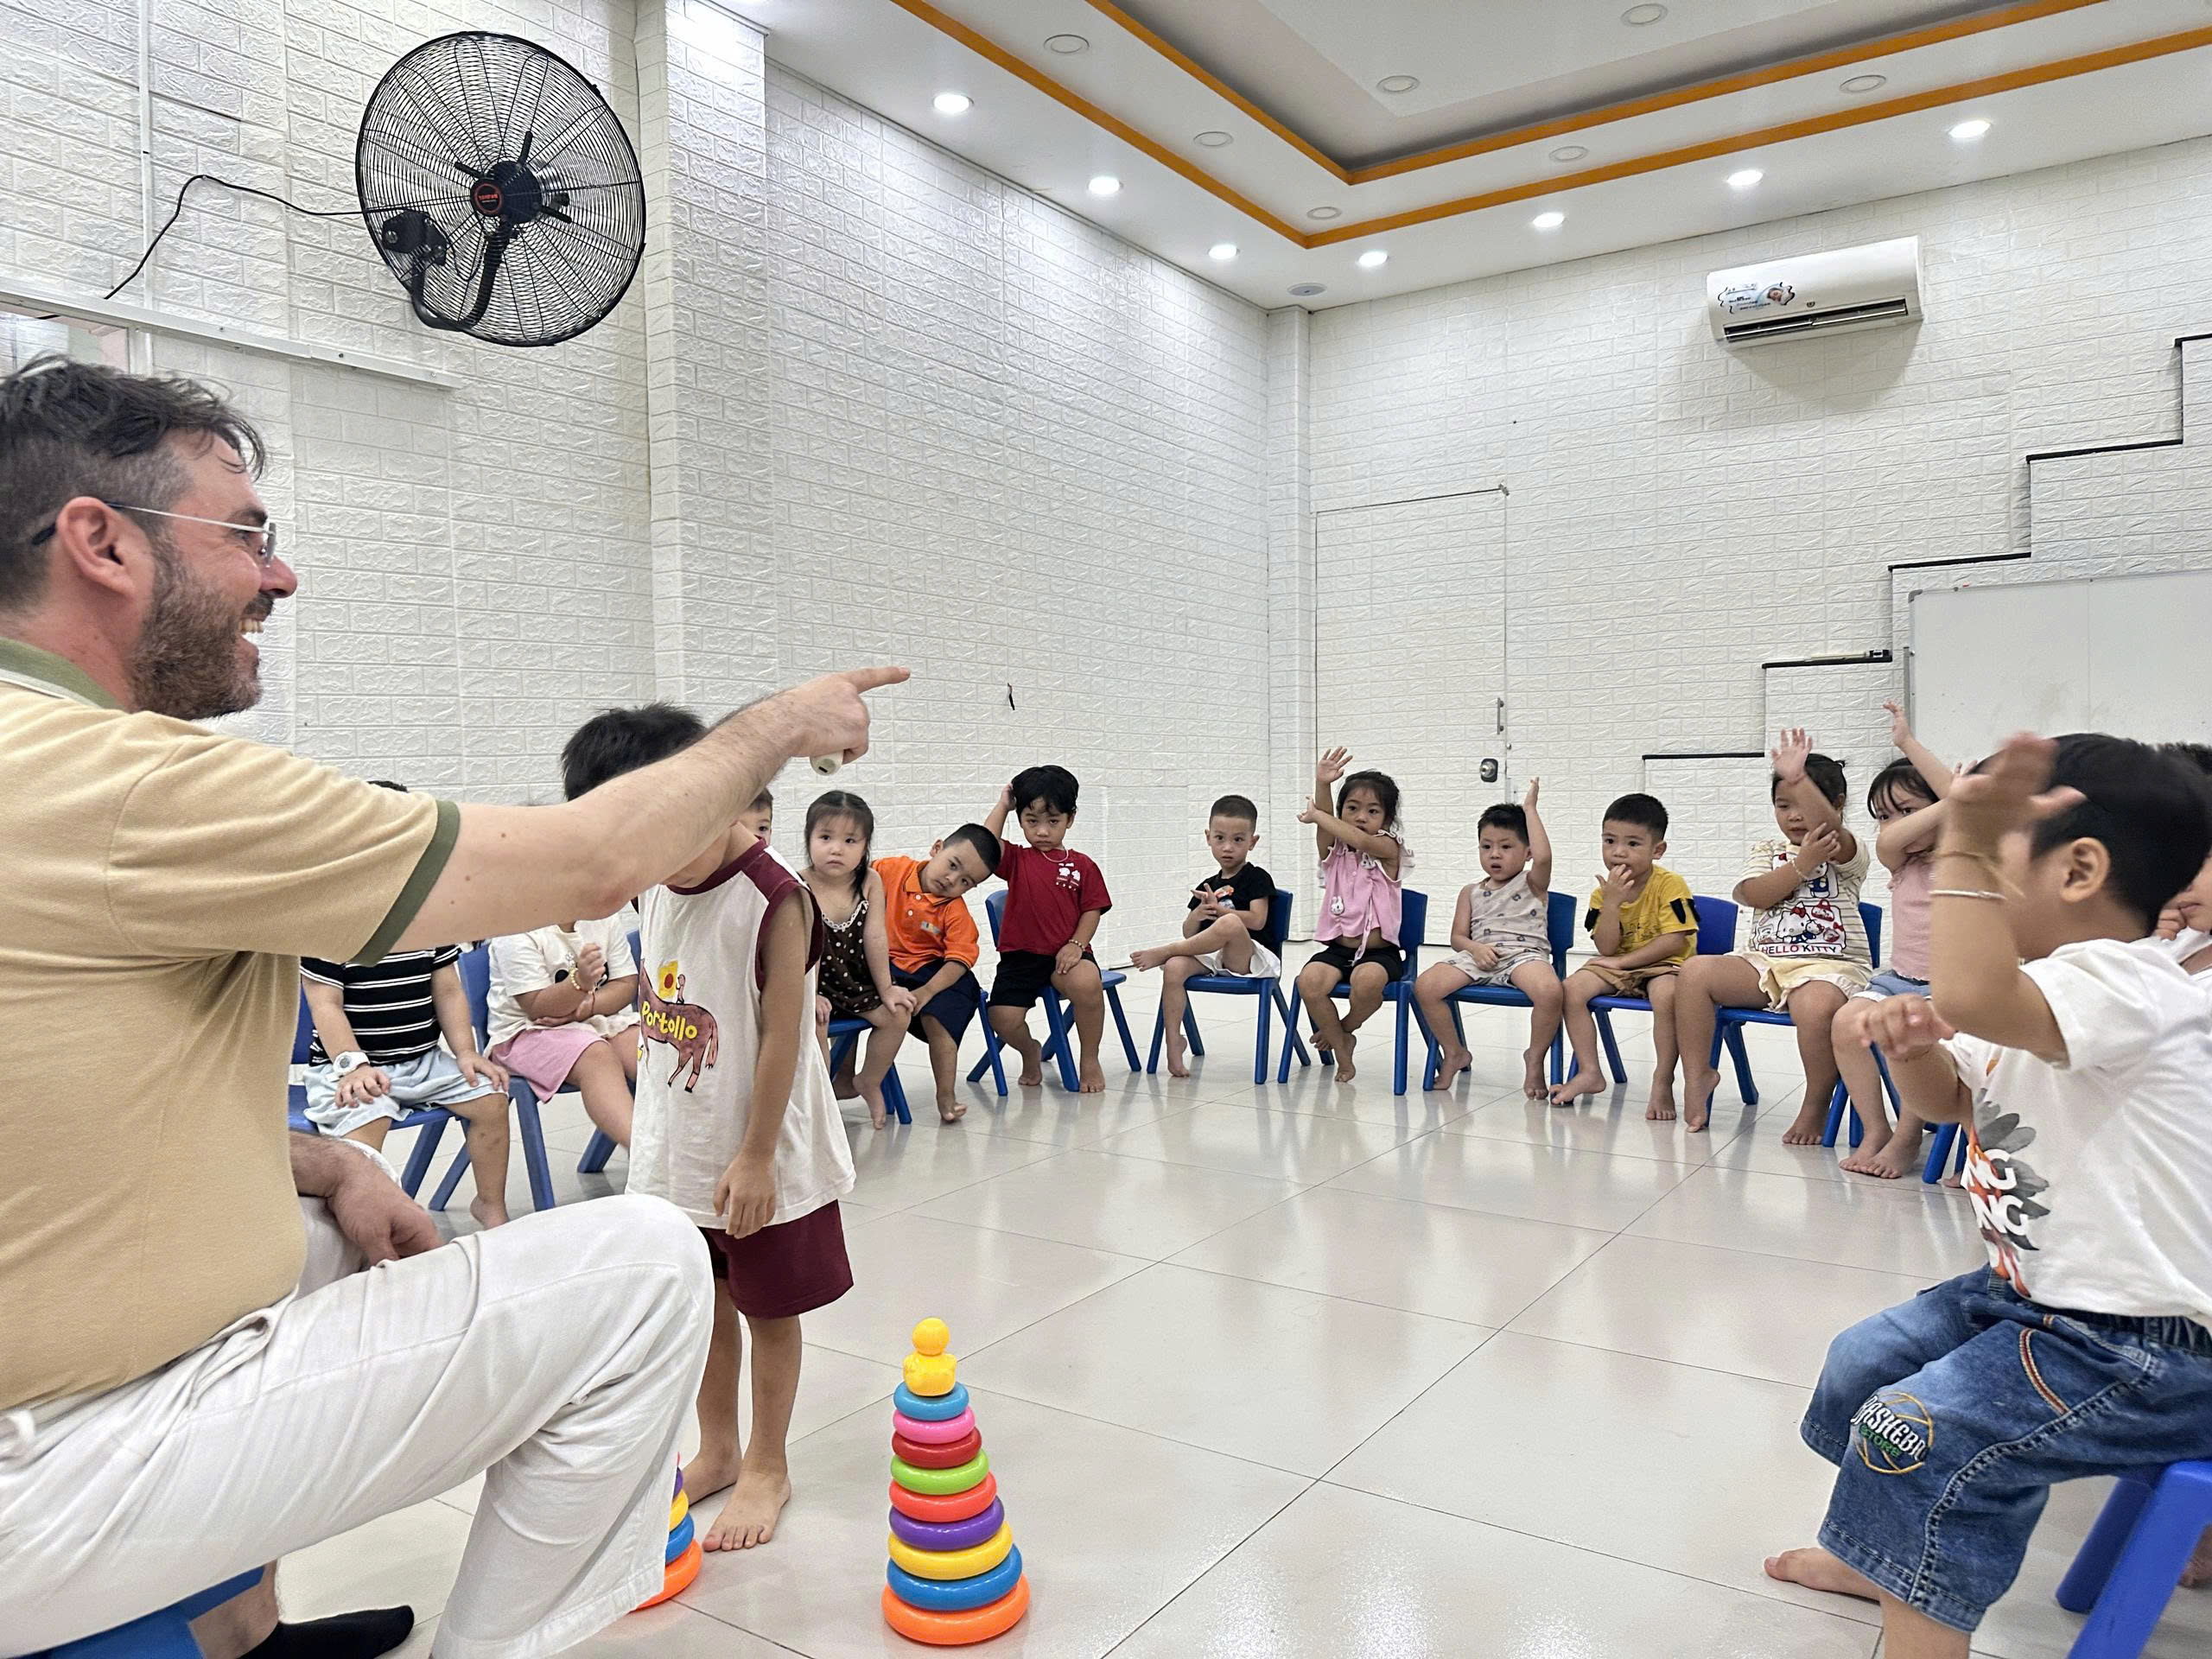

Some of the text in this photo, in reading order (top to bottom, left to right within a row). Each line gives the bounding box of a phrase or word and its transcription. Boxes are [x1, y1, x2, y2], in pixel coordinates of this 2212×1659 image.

[1762, 944, 1837, 955] HELLO KITTY
[1859, 1425, 1901, 1458] STORE
